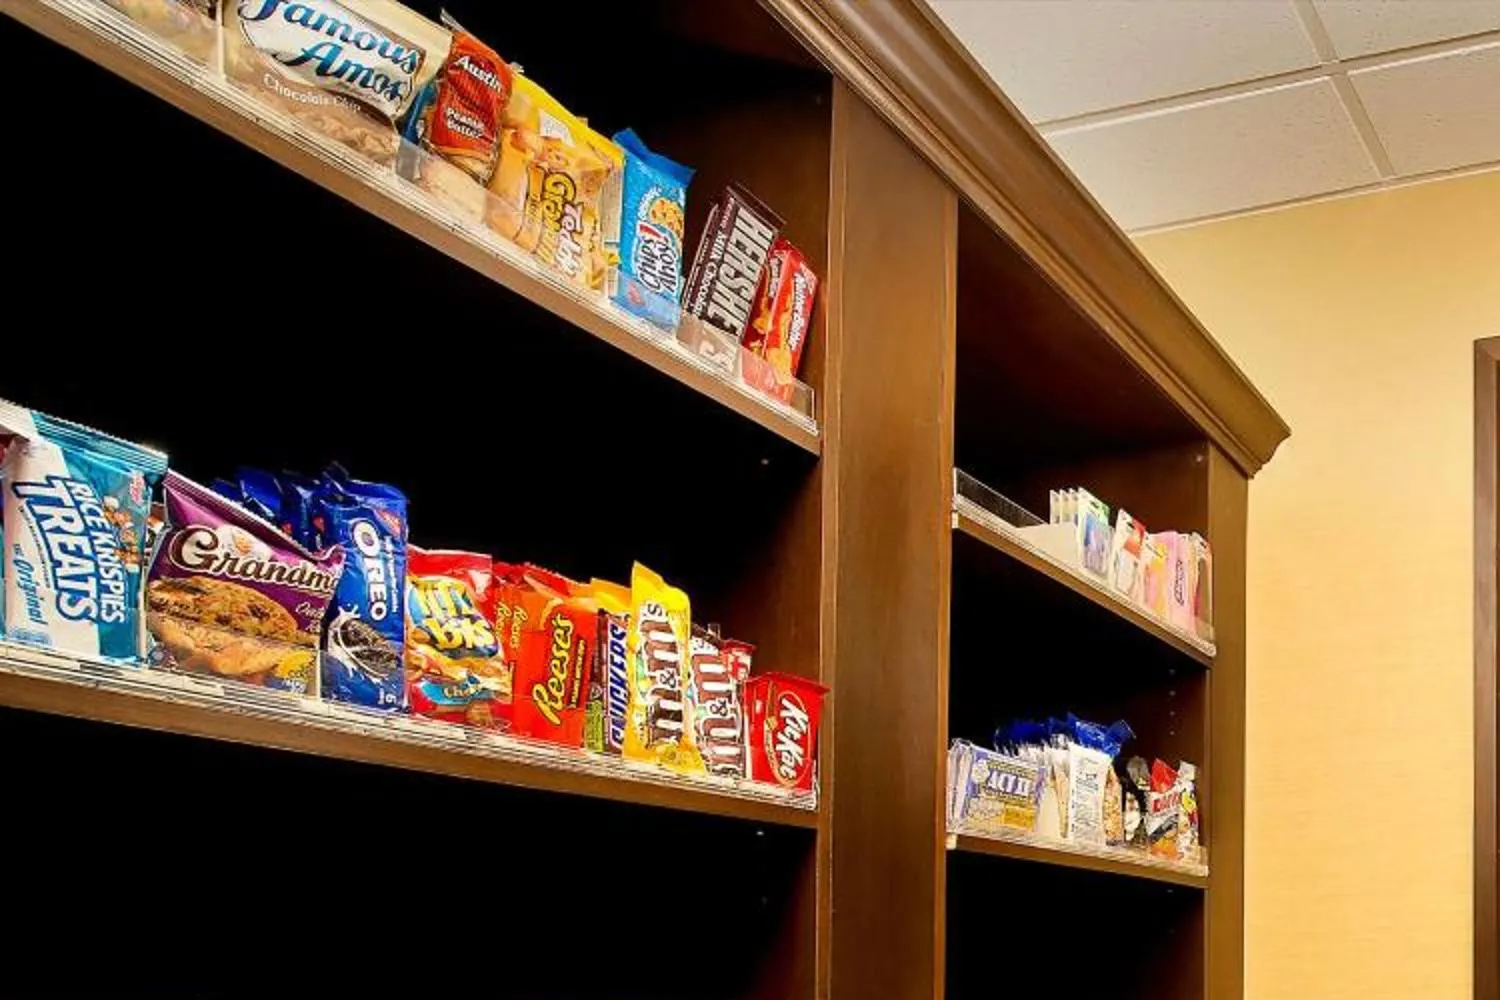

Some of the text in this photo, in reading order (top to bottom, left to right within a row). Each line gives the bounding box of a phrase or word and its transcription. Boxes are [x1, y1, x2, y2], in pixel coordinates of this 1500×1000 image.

[275, 41, 402, 102] Amos
[454, 55, 502, 92] Austin
[12, 475, 100, 622] TREATS
[66, 478, 127, 625] RICE KRISPIES
[353, 520, 388, 622] OREO
[532, 613, 574, 726] Reese's
